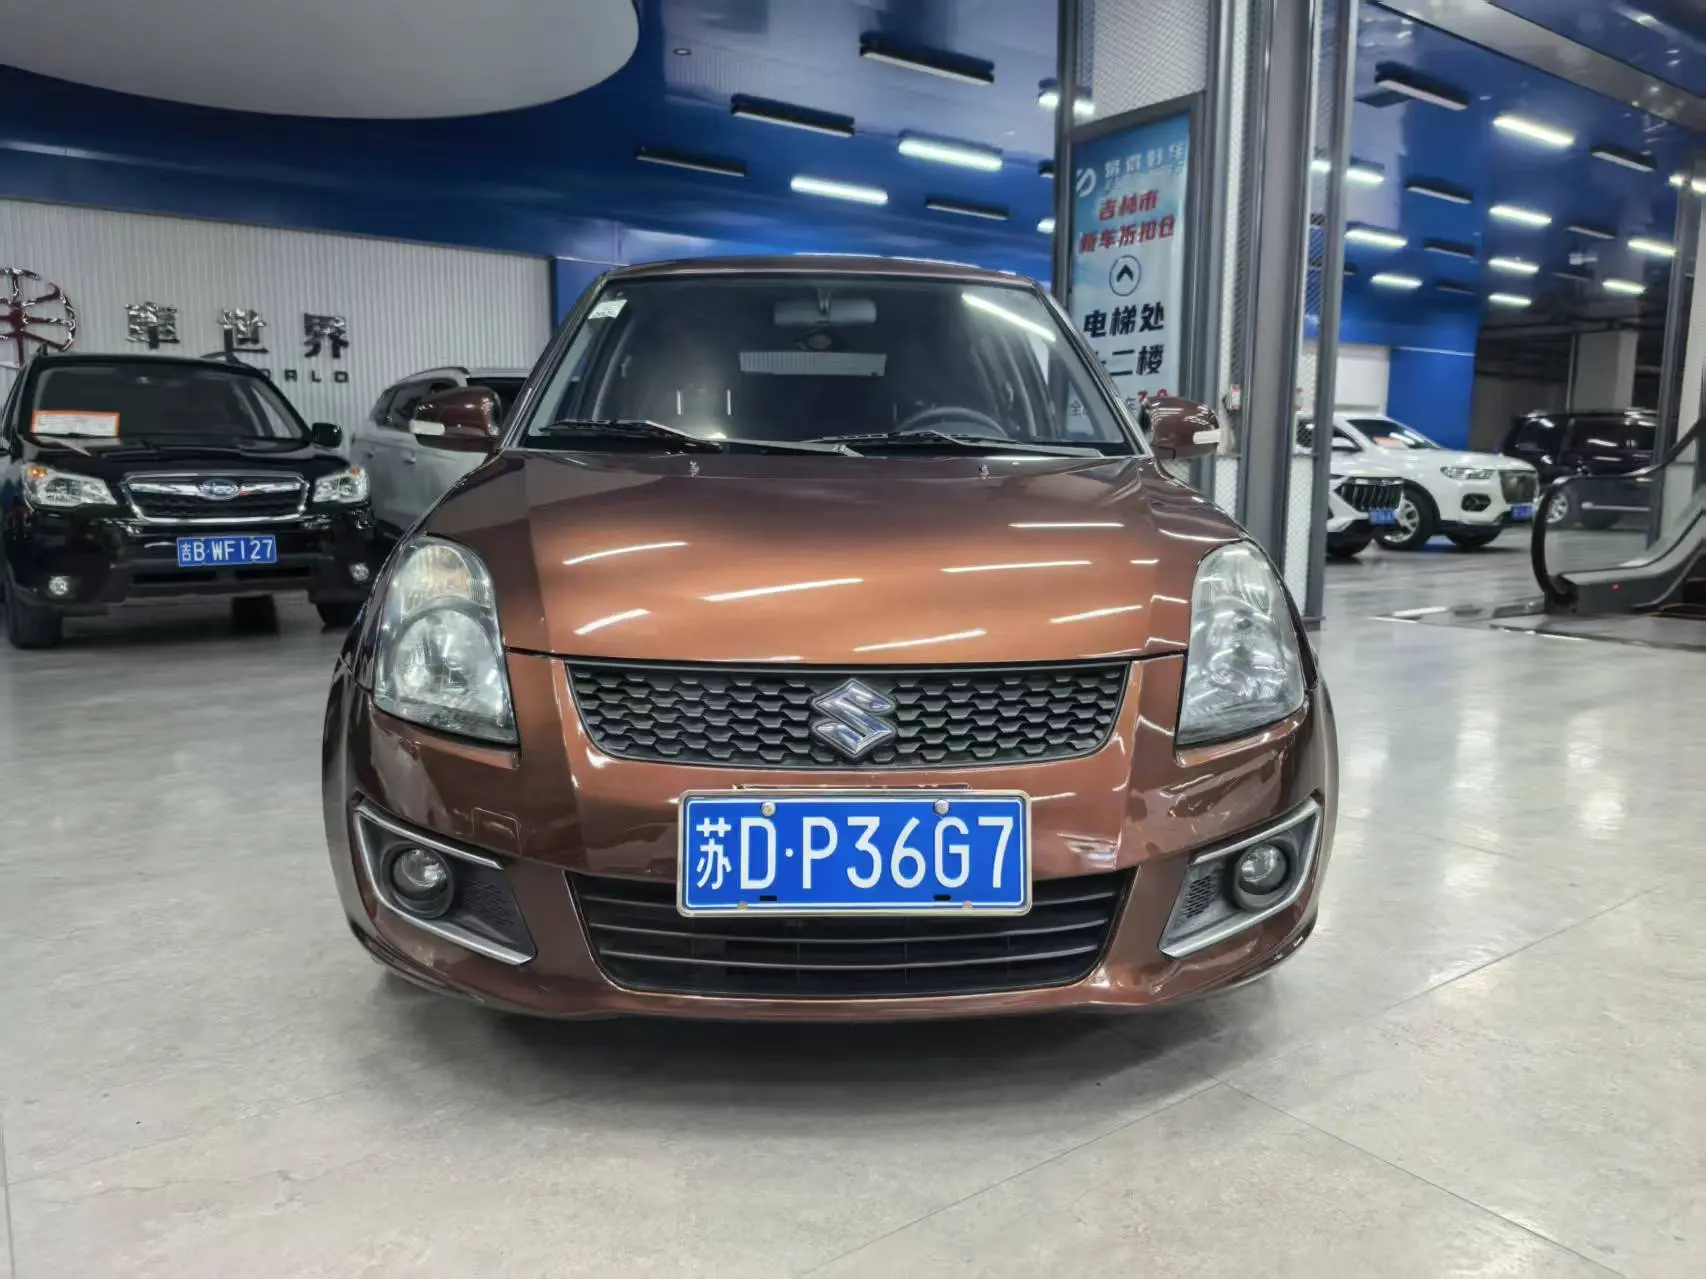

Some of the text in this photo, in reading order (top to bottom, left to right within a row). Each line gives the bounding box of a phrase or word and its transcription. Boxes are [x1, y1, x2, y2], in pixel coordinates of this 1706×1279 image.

[1098, 190, 1159, 220] 吉林市
[1083, 301, 1164, 338] 电梯处
[695, 816, 1014, 891] 苏D·P36G7
